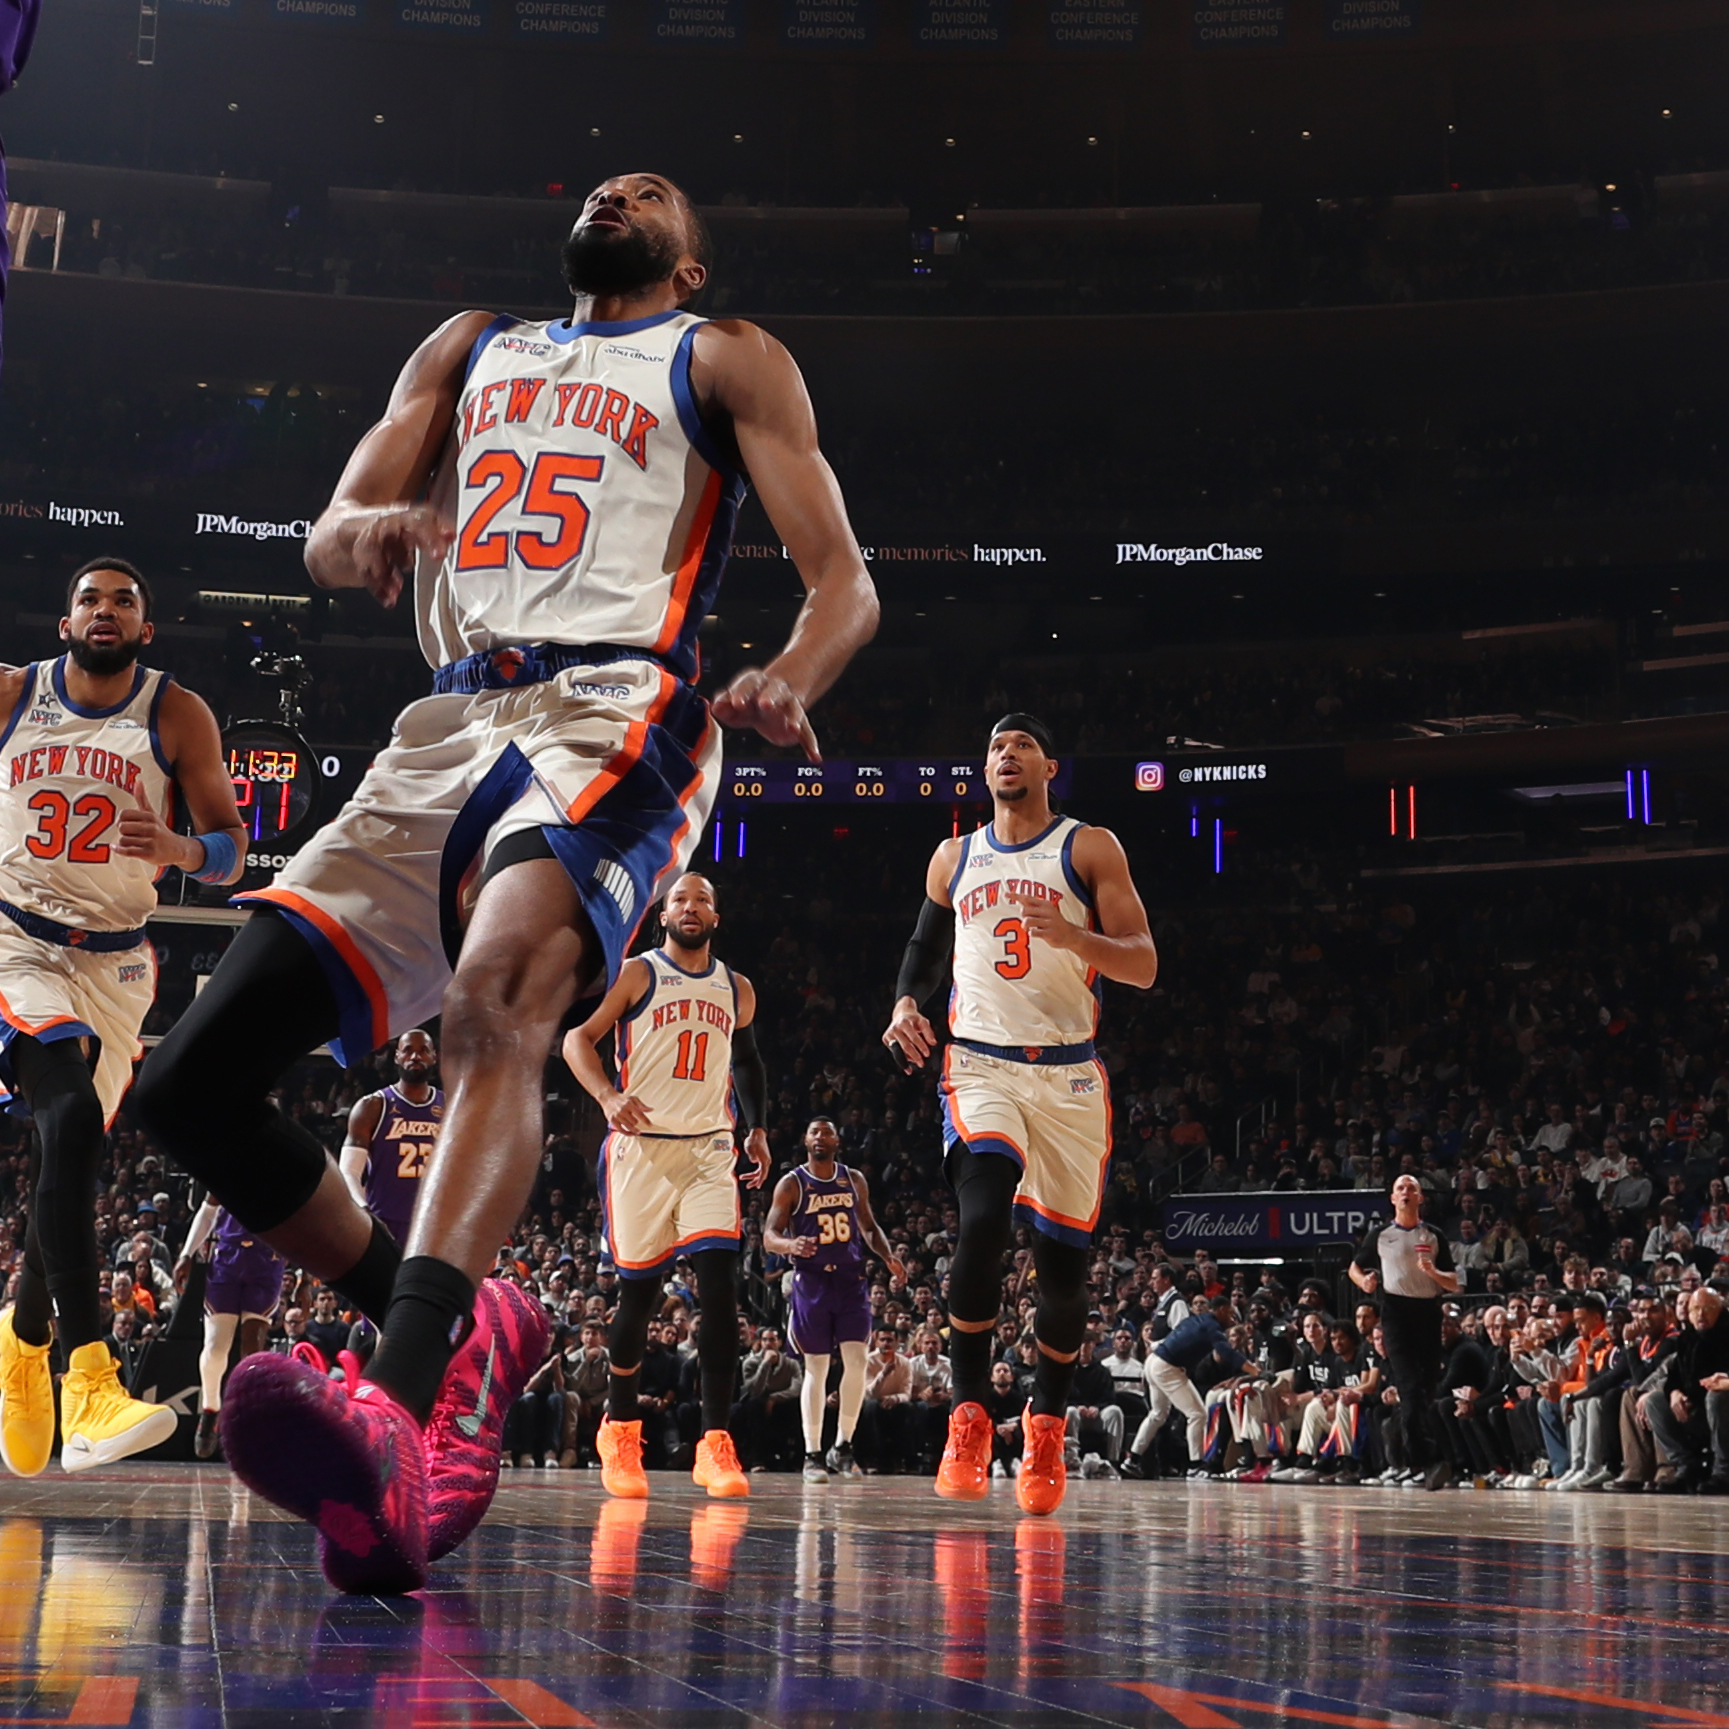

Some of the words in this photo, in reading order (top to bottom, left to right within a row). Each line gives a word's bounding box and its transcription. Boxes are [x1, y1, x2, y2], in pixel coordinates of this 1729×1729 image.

[277, 0, 357, 17] CHAMPIONS
[515, 1, 606, 18] CONFERENCE
[668, 8, 725, 21] DIVISION
[1194, 8, 1284, 23] CONFERENCE
[1343, 0, 1400, 14] DIVISION
[402, 9, 481, 27] CHAMPIONS
[799, 10, 855, 23] DIVISION
[931, 12, 988, 24] DIVISION
[1051, 12, 1139, 24] CONFERENCE
[1332, 16, 1412, 32] CHAMPIONS
[520, 18, 599, 34] CHAMPIONS
[657, 24, 735, 38] CHAMPIONS
[787, 26, 866, 40] CHAMPIONS
[920, 28, 998, 41] CHAMPIONS
[1200, 25, 1278, 40] CHAMPIONS
[1056, 29, 1133, 41] CHAMPIONS
[458, 379, 547, 455] NEW
[552, 382, 660, 471] YORK
[48, 502, 124, 528] happen.
[456, 450, 606, 572] 25
[195, 513, 316, 541] JPMorganCh
[879, 541, 968, 561] memories
[973, 542, 1047, 565] happen.
[1116, 542, 1263, 566] JPMorganChase
[204, 594, 249, 606] GARDEN
[10, 745, 69, 788] NEW
[76, 746, 141, 796] YORK
[322, 756, 341, 777] 0
[735, 767, 766, 776] 3PT%
[798, 767, 822, 776] FG%
[858, 767, 882, 776] FT%
[919, 767, 935, 776] TO
[951, 766, 973, 776] STL
[1179, 764, 1266, 783] @NYKNICKS
[733, 782, 762, 796] 0.0
[794, 782, 823, 796] 0.0
[855, 782, 884, 796] 0.0
[920, 782, 932, 796] 0
[955, 782, 967, 796] 0
[26, 790, 115, 863] 32
[958, 880, 1000, 926] NEW
[993, 918, 1032, 980] 3
[652, 999, 691, 1032] NEW
[696, 999, 733, 1037] YORK
[673, 1030, 709, 1081] 11
[804, 1193, 853, 1215] LAKERS
[818, 1213, 851, 1245] 36
[1165, 1210, 1259, 1239] Michelob
